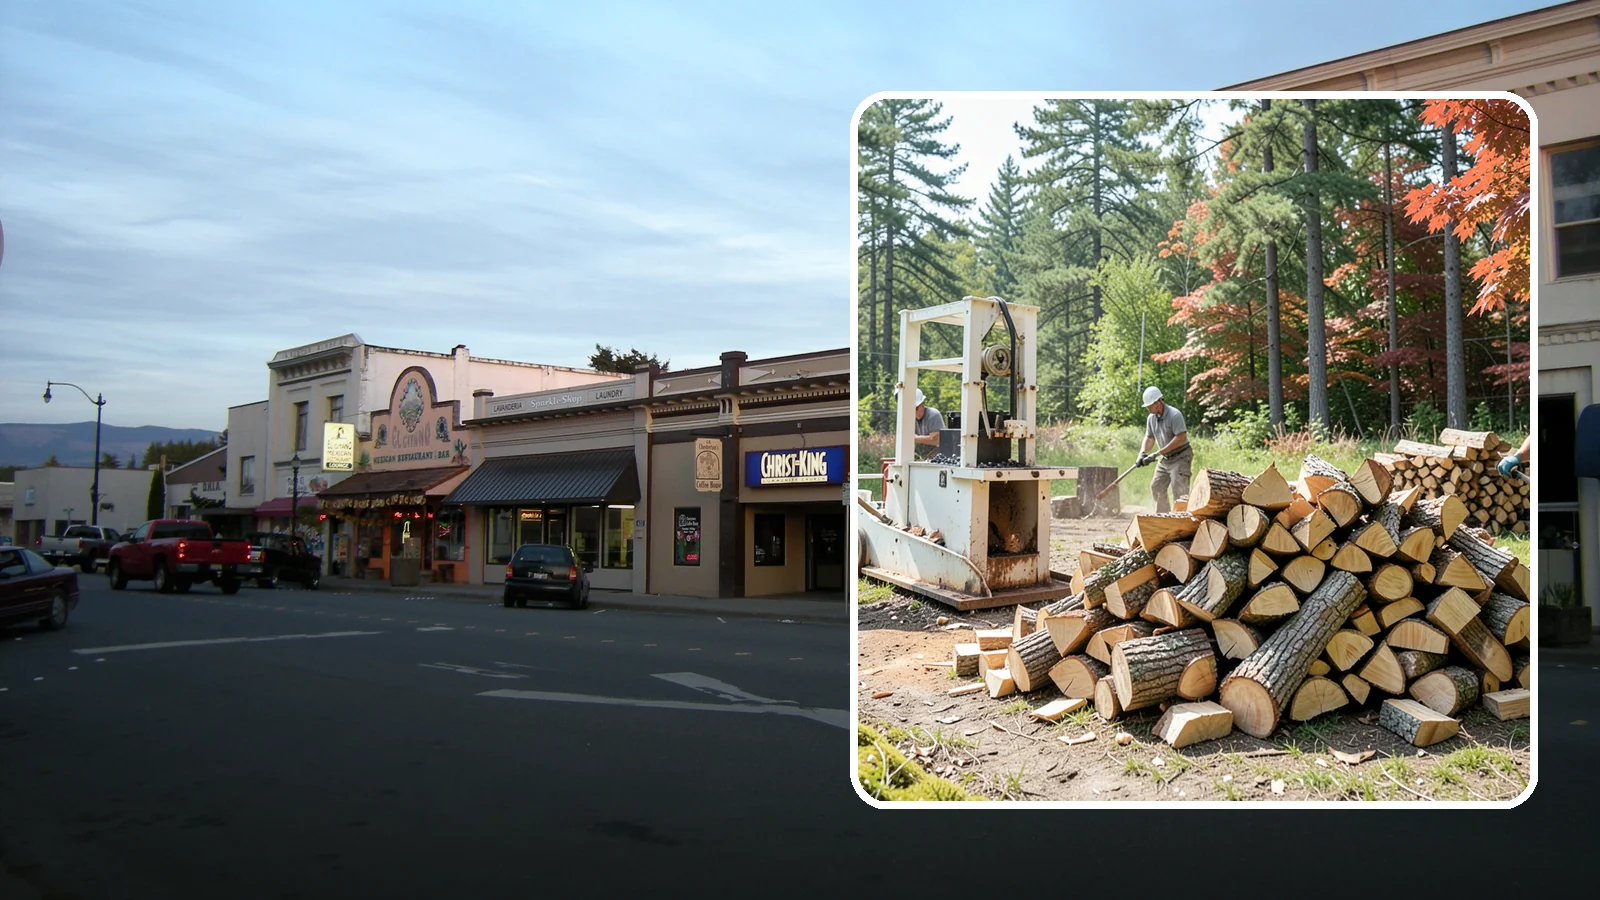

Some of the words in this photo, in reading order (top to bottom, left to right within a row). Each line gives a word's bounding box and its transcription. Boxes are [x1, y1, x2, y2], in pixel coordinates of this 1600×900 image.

[595, 389, 624, 399] LAUNDRY
[494, 402, 522, 412] LAVANDERIA
[373, 455, 396, 464] MEXICAN
[397, 451, 433, 462] RESTAURANT
[438, 449, 450, 459] BAR
[760, 452, 798, 478] CHRIST
[799, 450, 827, 477] KING
[696, 480, 709, 489] Coffee
[710, 480, 722, 489] House
